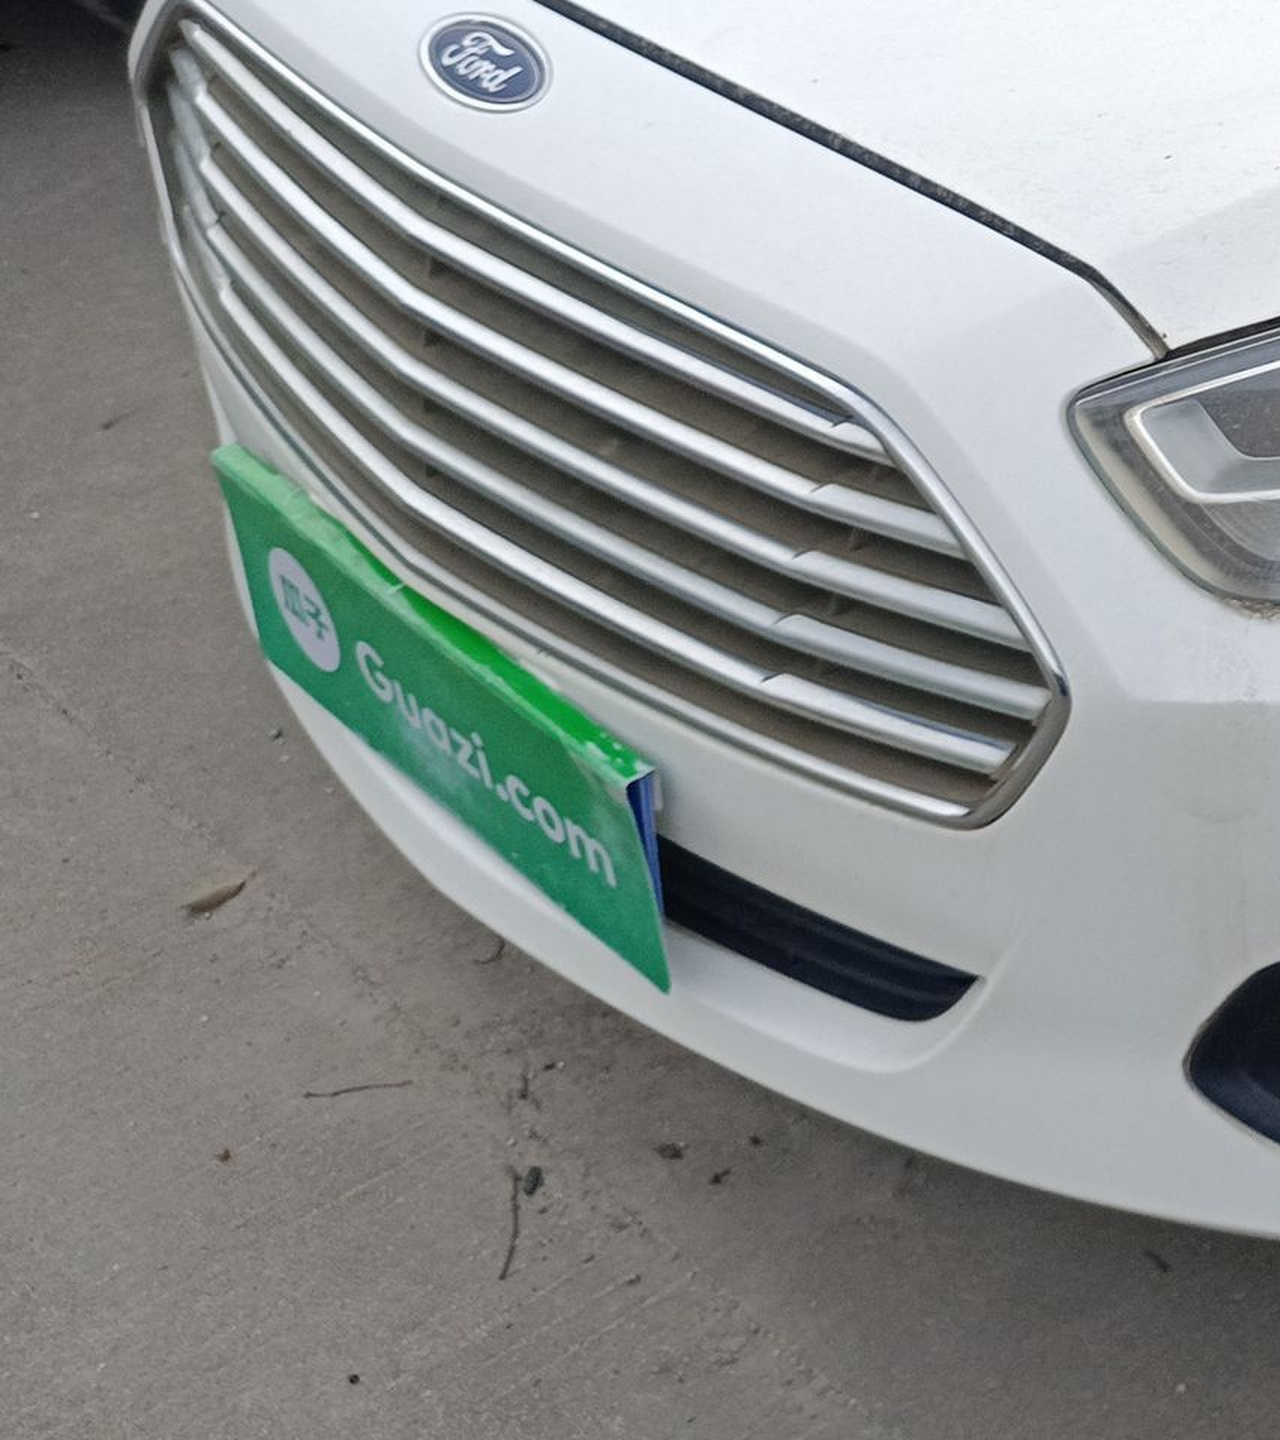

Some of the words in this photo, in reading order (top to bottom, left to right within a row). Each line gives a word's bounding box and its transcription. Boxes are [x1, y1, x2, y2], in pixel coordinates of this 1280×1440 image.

[441, 31, 523, 93] Ford
[280, 575, 328, 641] 瓜子
[355, 641, 617, 888] Guazi.com
